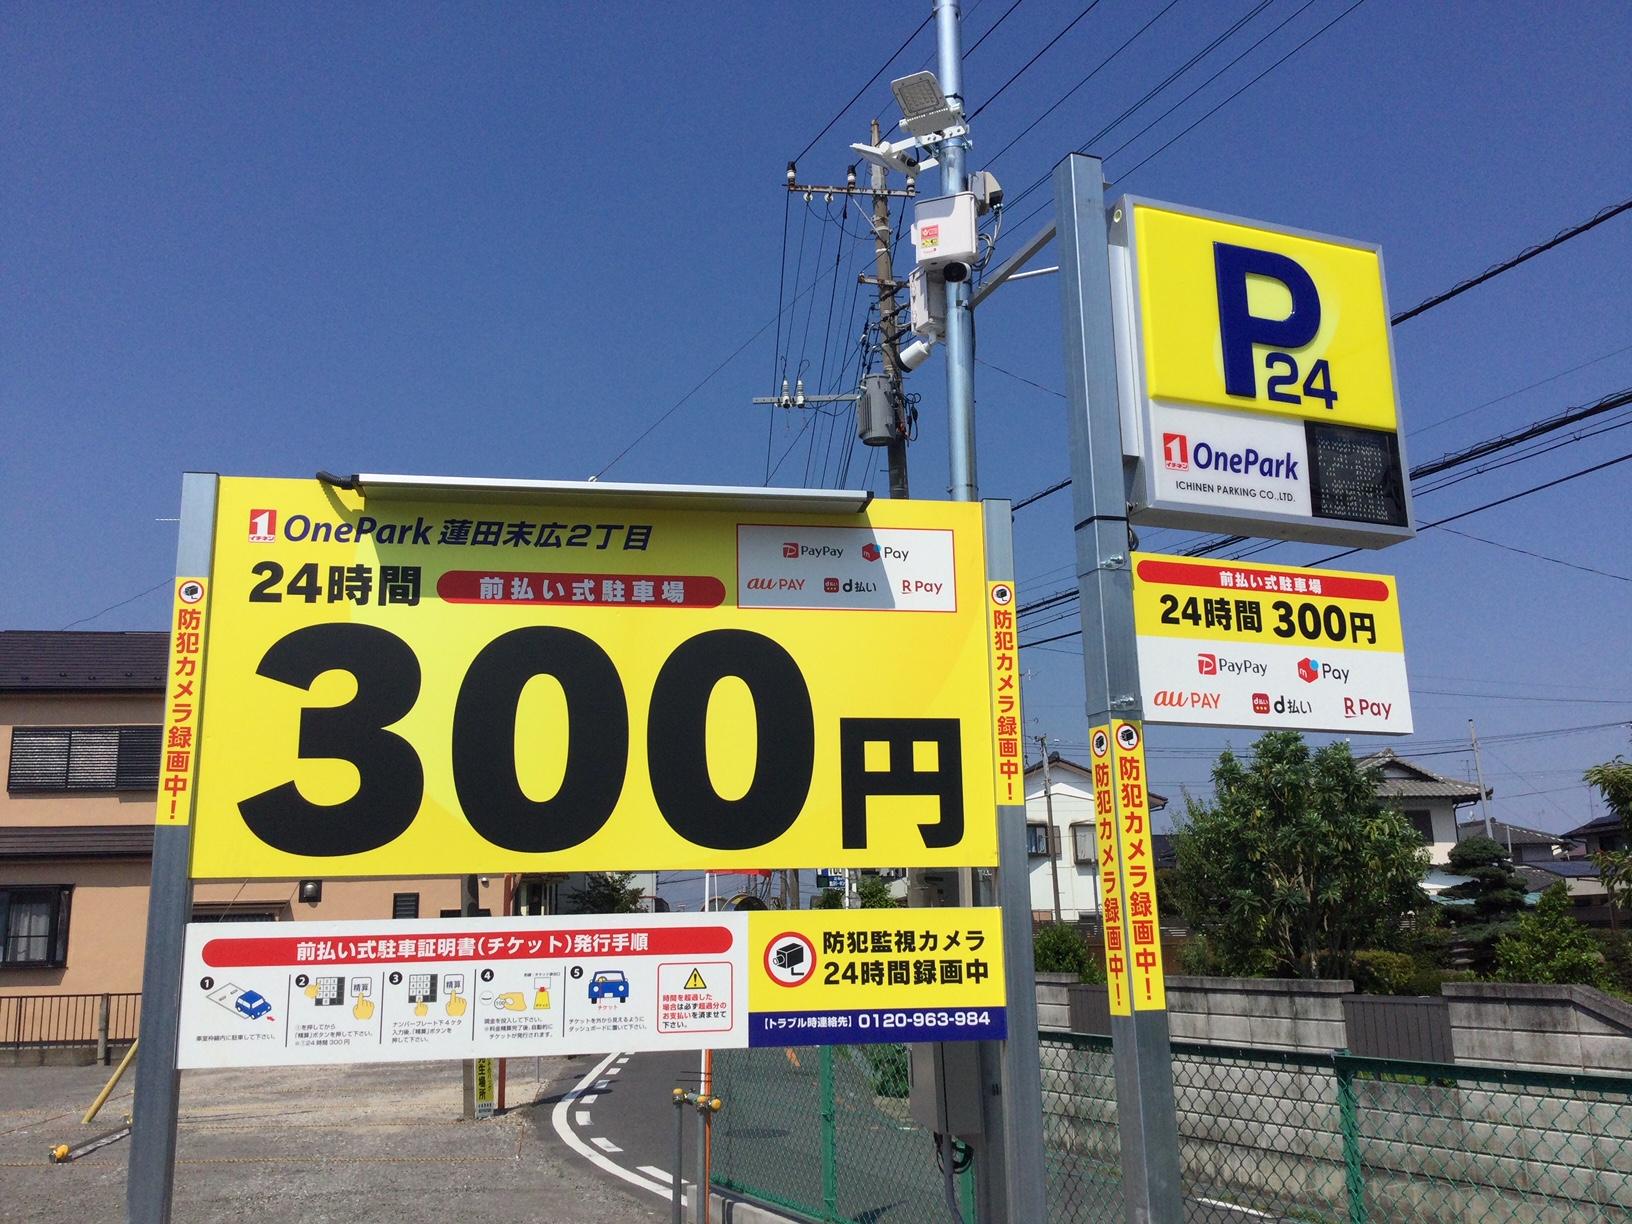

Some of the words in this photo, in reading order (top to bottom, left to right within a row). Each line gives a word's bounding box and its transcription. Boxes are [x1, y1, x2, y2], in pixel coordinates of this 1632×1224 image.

[1213, 241, 1322, 399] P
[1265, 352, 1338, 410] 24
[1192, 442, 1299, 481] OnePark
[1175, 480, 1215, 494] ICHINEN
[1216, 484, 1257, 499] PARKING
[1258, 488, 1296, 503] CO.,LTD.
[283, 514, 436, 546] OnePark
[437, 518, 653, 552] 蓮田末広2丁目
[801, 545, 844, 560] PayPay
[884, 547, 910, 563] Pay
[248, 559, 423, 607] 24時間
[478, 575, 686, 606] 前払い式駐車場
[747, 577, 777, 591] au
[778, 579, 805, 591] PAY
[843, 578, 877, 593] d払い
[915, 580, 943, 596] Pay
[1219, 570, 1323, 594] 前払い式駐車場
[1159, 593, 1263, 633] 24時間
[1272, 600, 1378, 645] 300円
[1219, 657, 1268, 677] PayPay
[1322, 662, 1350, 684] Pay
[1153, 690, 1189, 708] au
[1190, 692, 1221, 709] PAY
[1274, 695, 1313, 715] d払い
[1359, 698, 1392, 721] Pay
[238, 622, 965, 855] 300円
[296, 932, 649, 961] 前払い式駐車証明書(チケット)発行手順
[822, 930, 985, 954] 防犯監視カメラ
[823, 958, 989, 986] 24時間録画中
[857, 1010, 991, 1030] 0120-963-984
